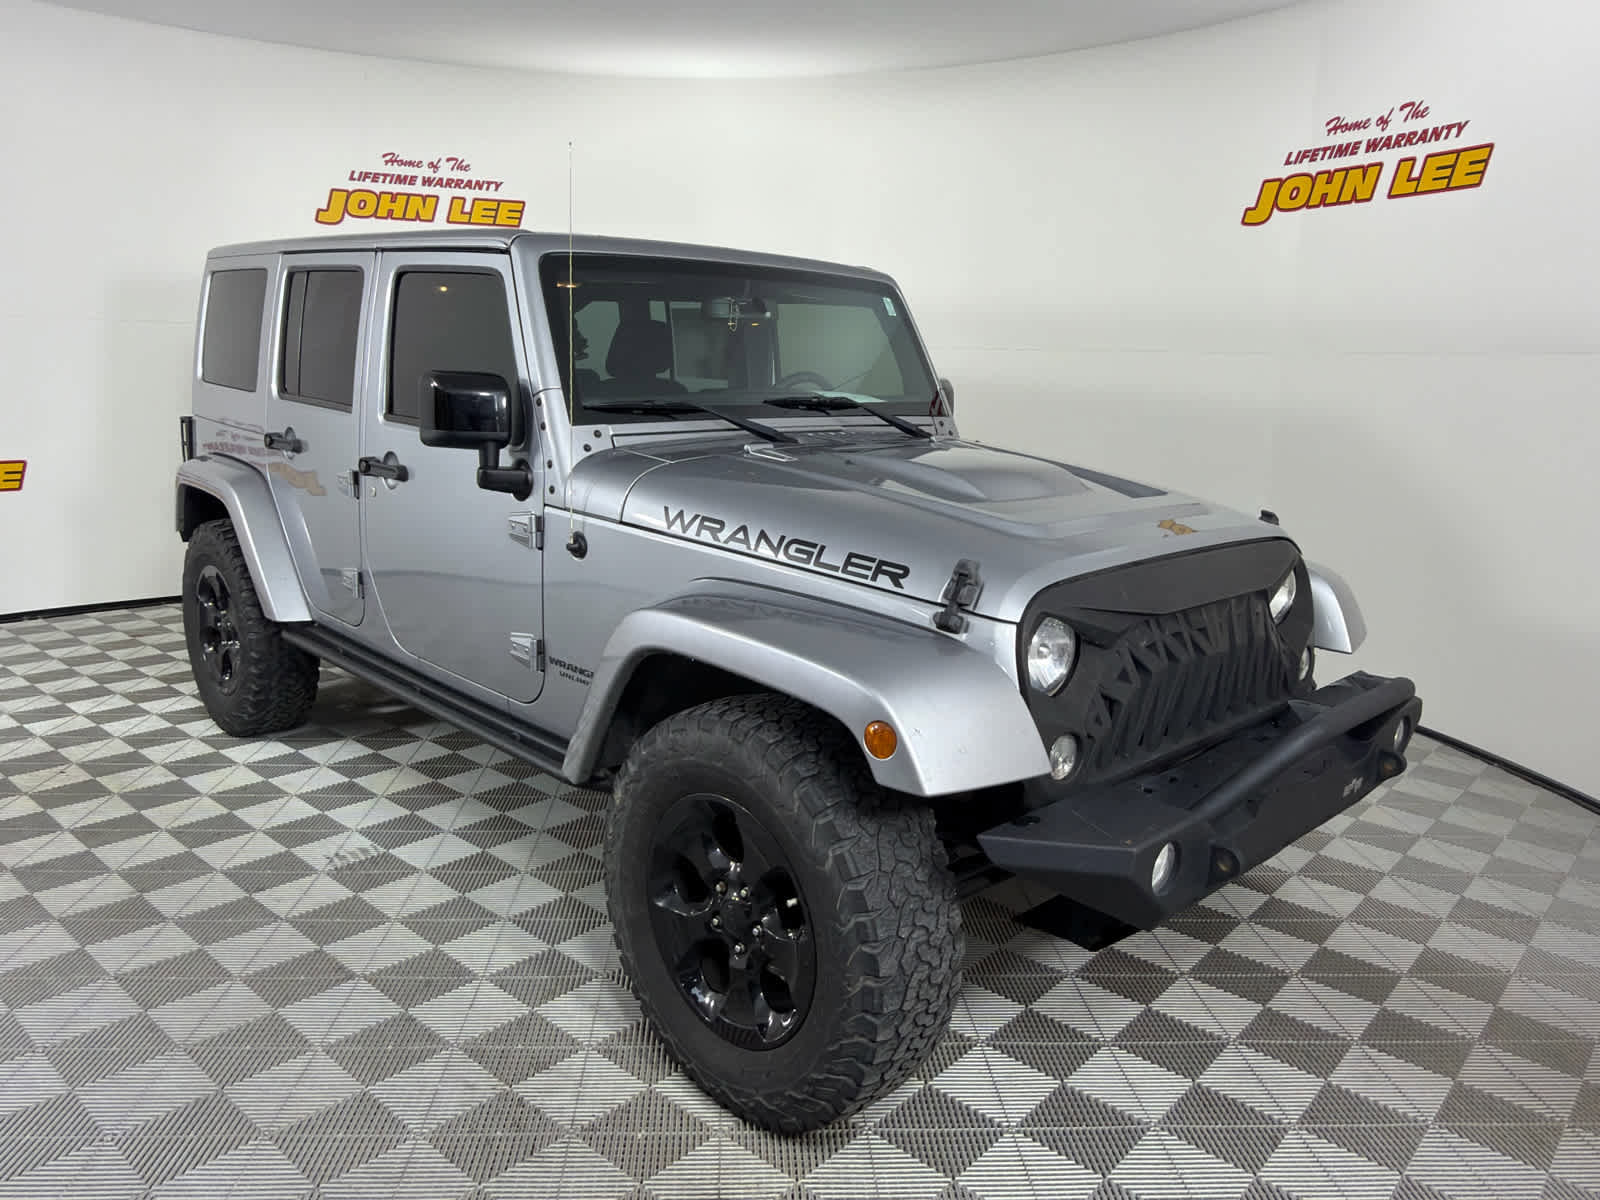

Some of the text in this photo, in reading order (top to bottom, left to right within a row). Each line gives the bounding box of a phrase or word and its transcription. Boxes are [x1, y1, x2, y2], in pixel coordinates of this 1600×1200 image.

[1324, 100, 1431, 137] Home of The
[1283, 120, 1471, 166] LIFETIME WARRANTY
[348, 170, 504, 192] LIFETIME WARRANTY
[382, 152, 471, 174] Home of The
[1241, 142, 1495, 227] JOHN LEE
[315, 188, 526, 228] JOHN LEE
[663, 505, 911, 590] WRANGLER
[548, 655, 594, 679] WRANG
